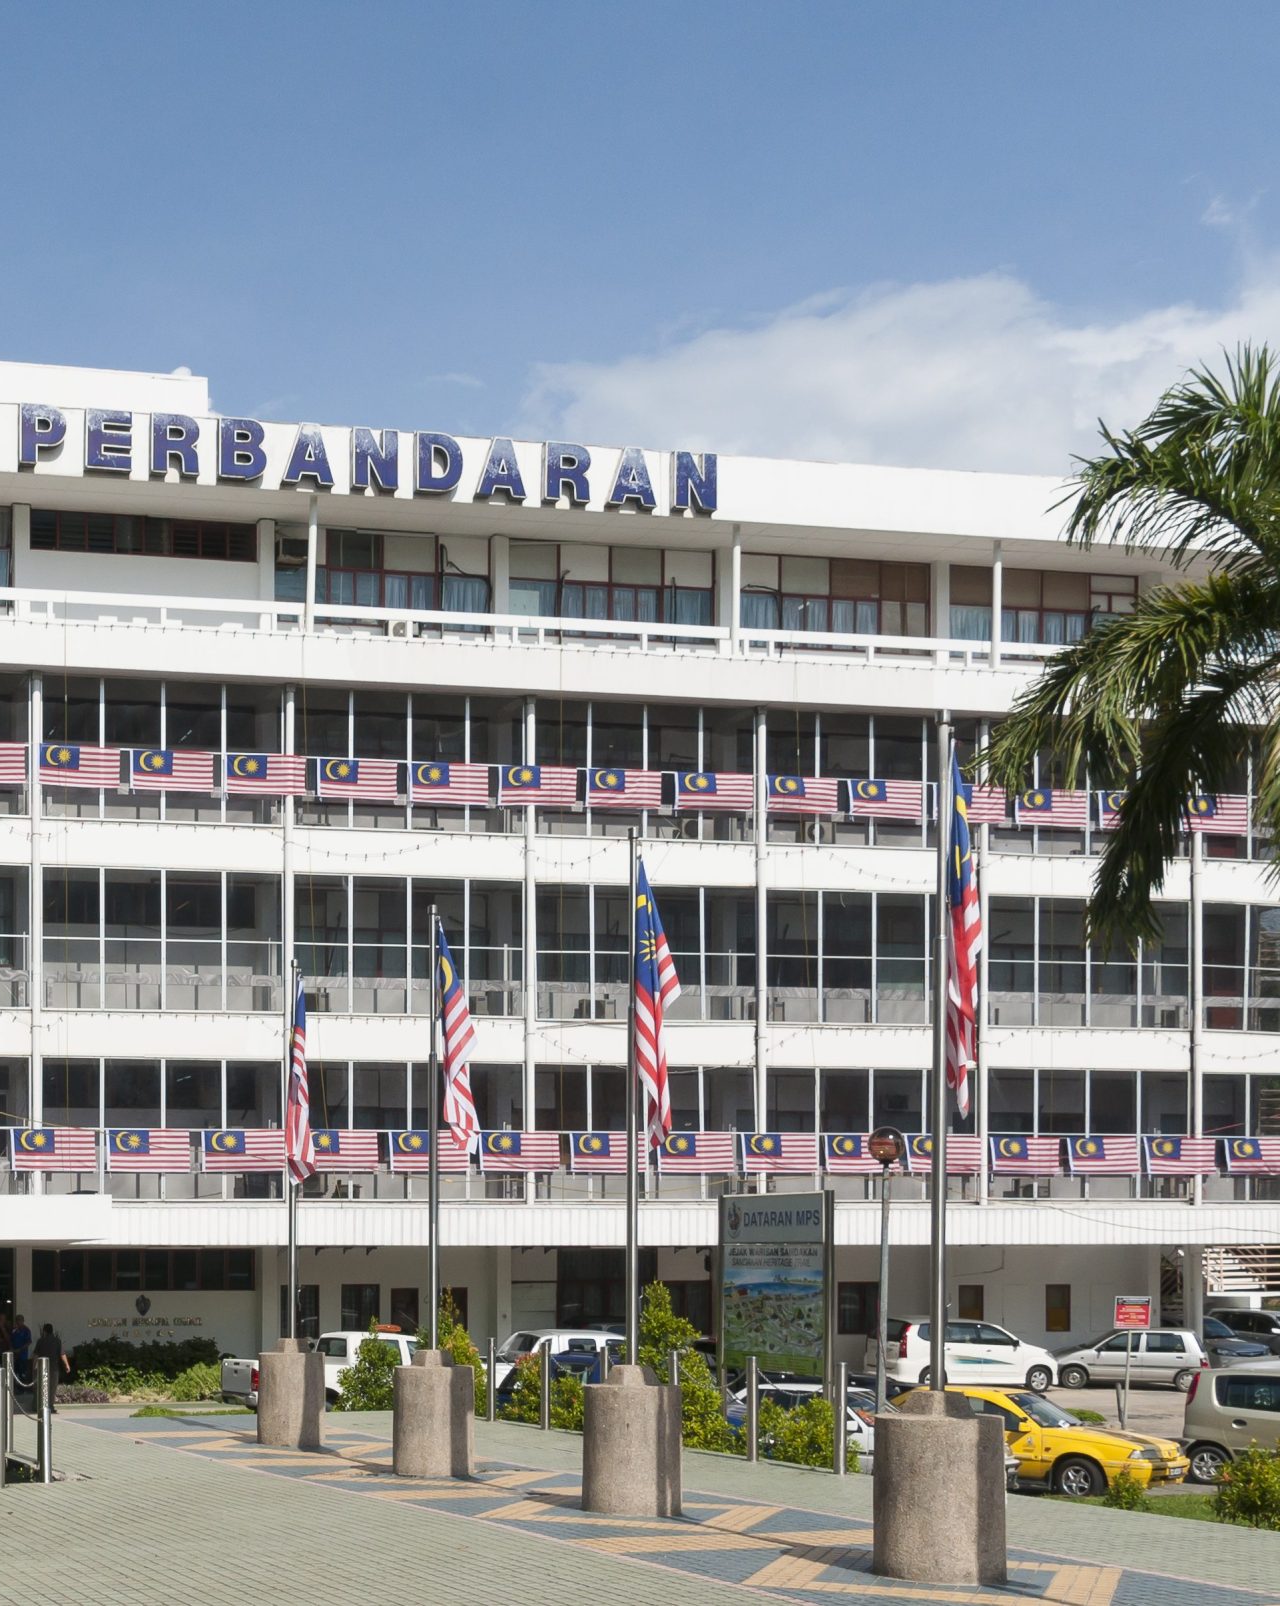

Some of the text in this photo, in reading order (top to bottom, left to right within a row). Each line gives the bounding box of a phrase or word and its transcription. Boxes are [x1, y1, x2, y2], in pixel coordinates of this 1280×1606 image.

[19, 402, 718, 511] PERBANDARAN
[743, 1209, 820, 1227] DATARAN MPS
